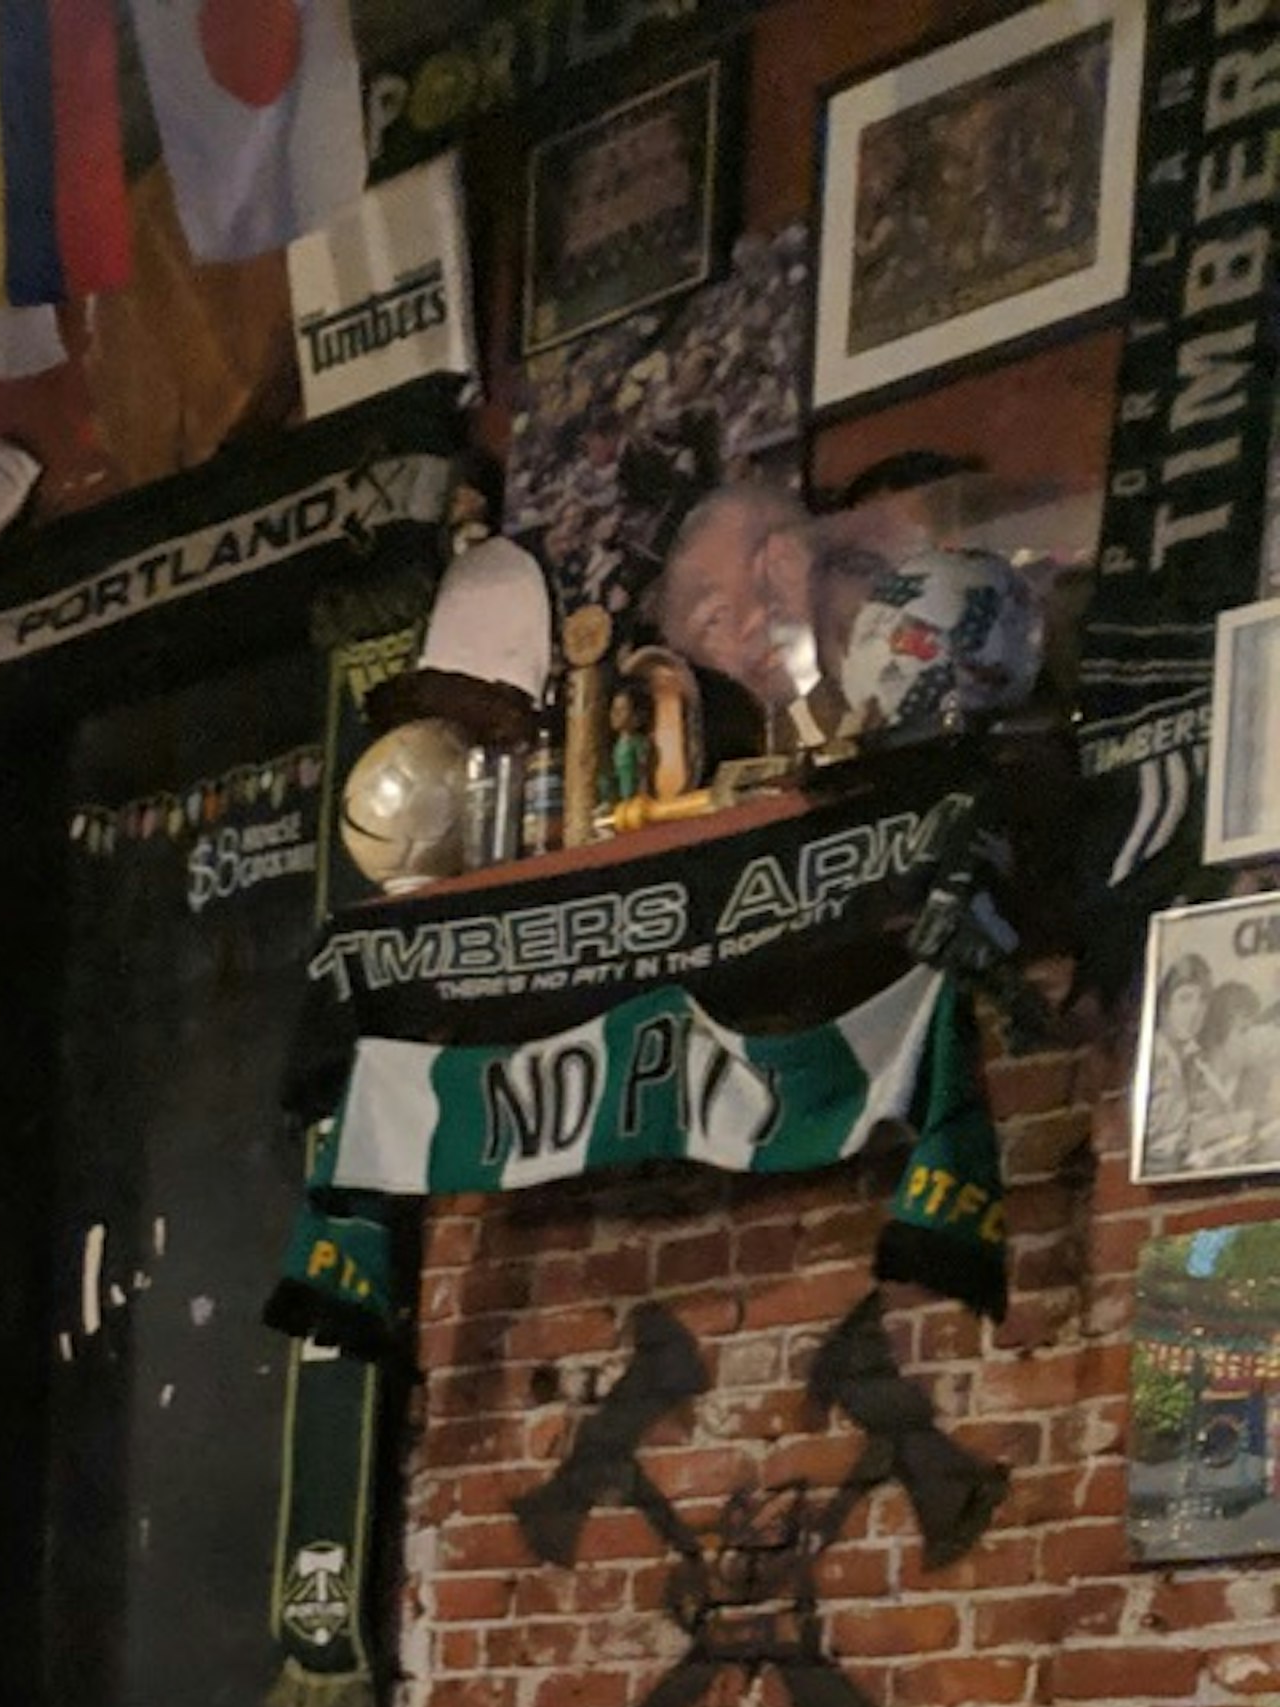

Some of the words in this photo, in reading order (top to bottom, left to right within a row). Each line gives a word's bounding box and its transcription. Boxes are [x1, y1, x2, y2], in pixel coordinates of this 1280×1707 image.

[14, 488, 336, 647] PORTLAND
[309, 883, 688, 1003] TIMBERS
[716, 811, 942, 936] ARM
[532, 970, 567, 991] NO
[571, 962, 627, 987] PITY
[634, 956, 660, 981] IN
[666, 945, 713, 975] THE
[481, 1038, 600, 1166] NO
